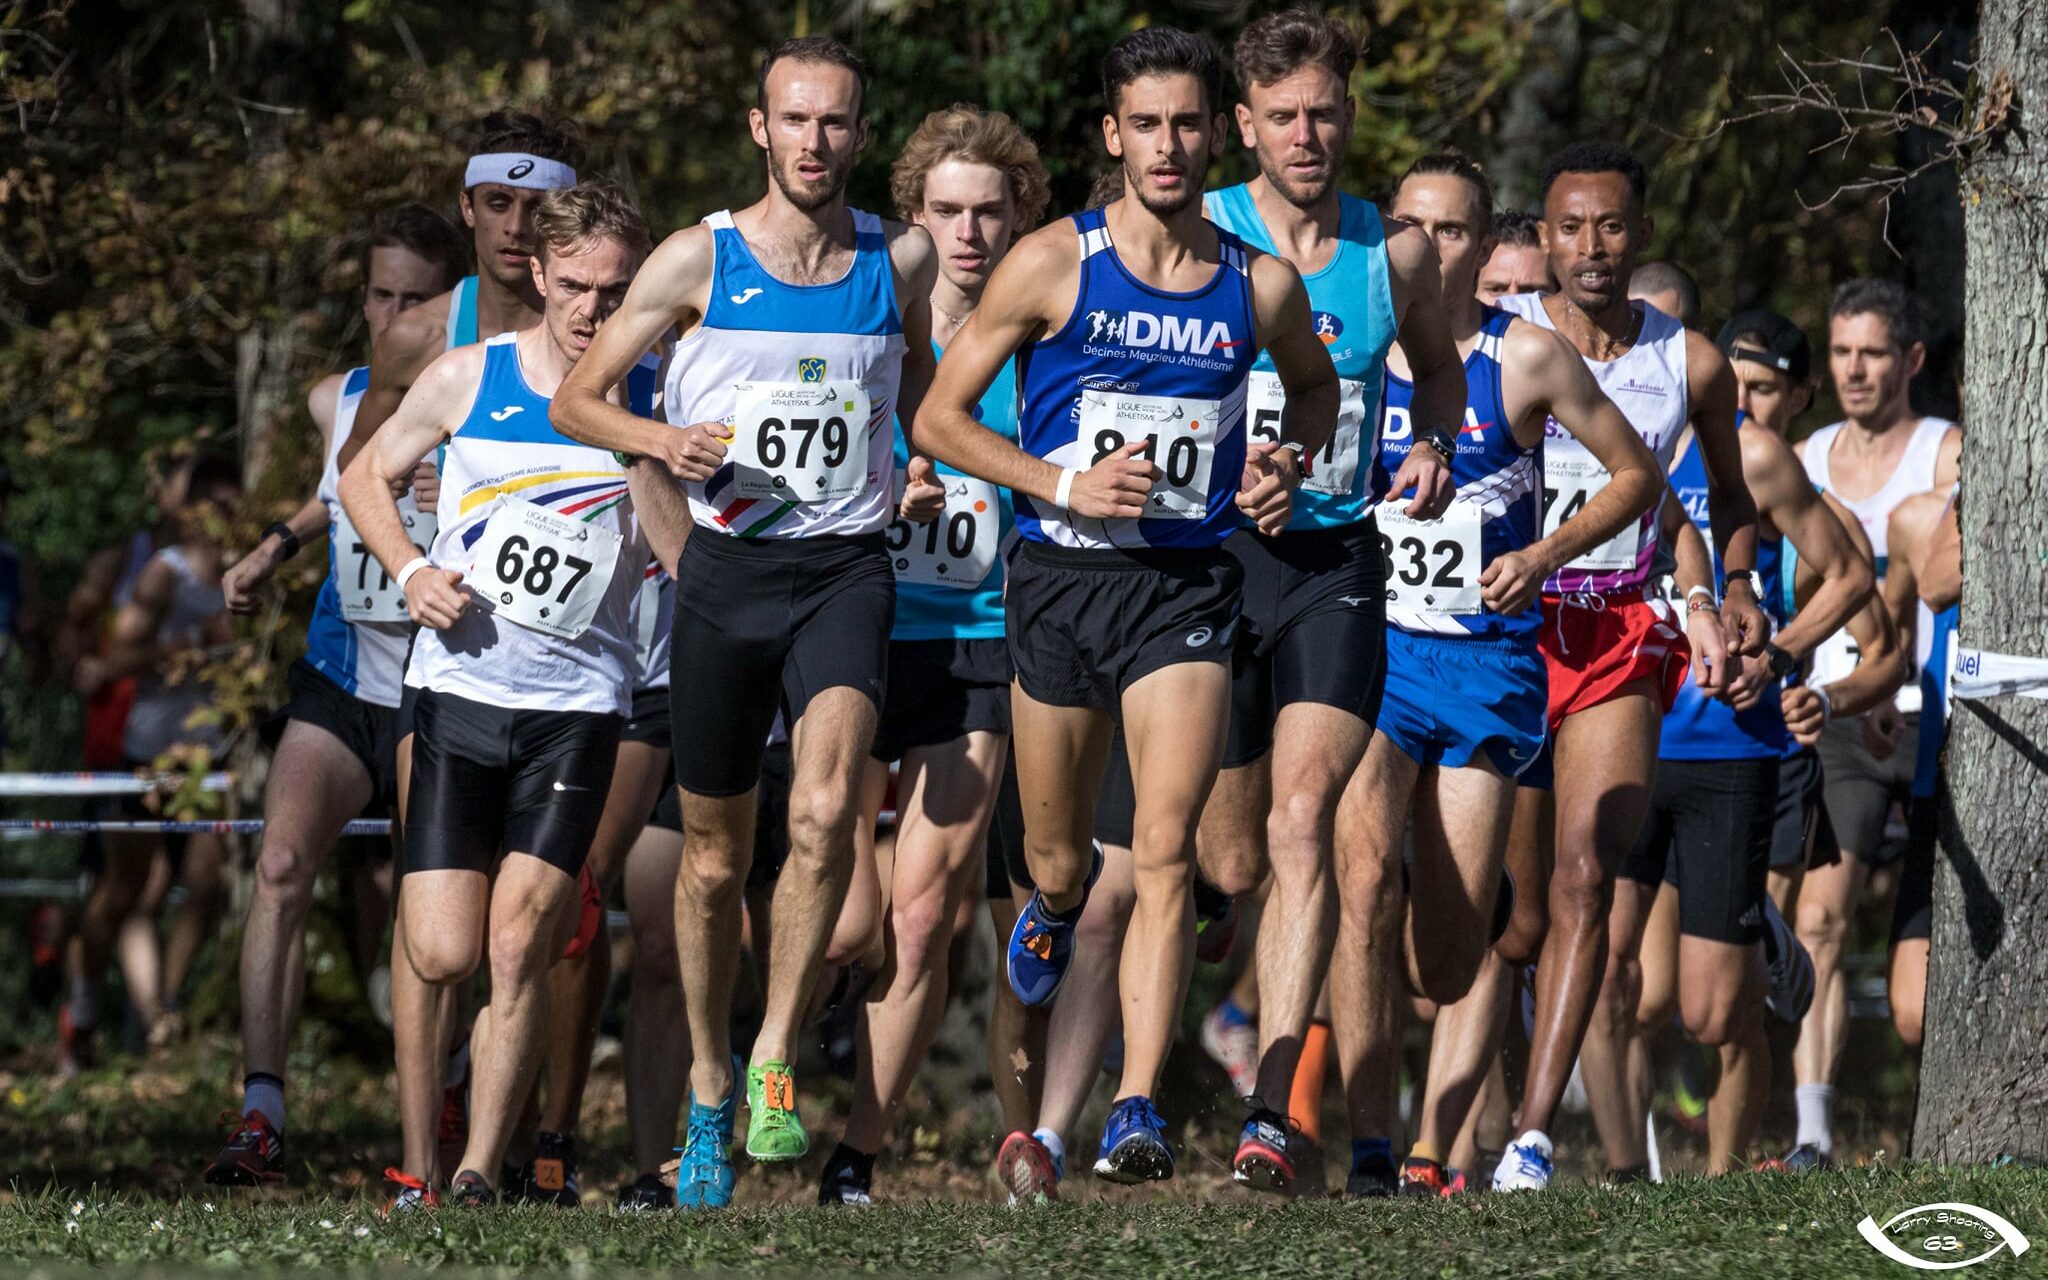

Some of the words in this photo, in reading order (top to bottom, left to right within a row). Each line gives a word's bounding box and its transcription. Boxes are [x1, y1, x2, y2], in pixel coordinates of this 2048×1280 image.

[1125, 311, 1237, 359] DMA
[1083, 344, 1127, 359] Décines
[1129, 349, 1176, 365] Meyzieu
[1178, 354, 1235, 373] Athlétisme
[771, 390, 795, 399] LIGUE
[1117, 402, 1141, 412] LIGUE
[1116, 412, 1156, 421] ATHLETISME
[756, 416, 849, 469] 679
[886, 503, 977, 559] 510
[495, 534, 593, 605] 687
